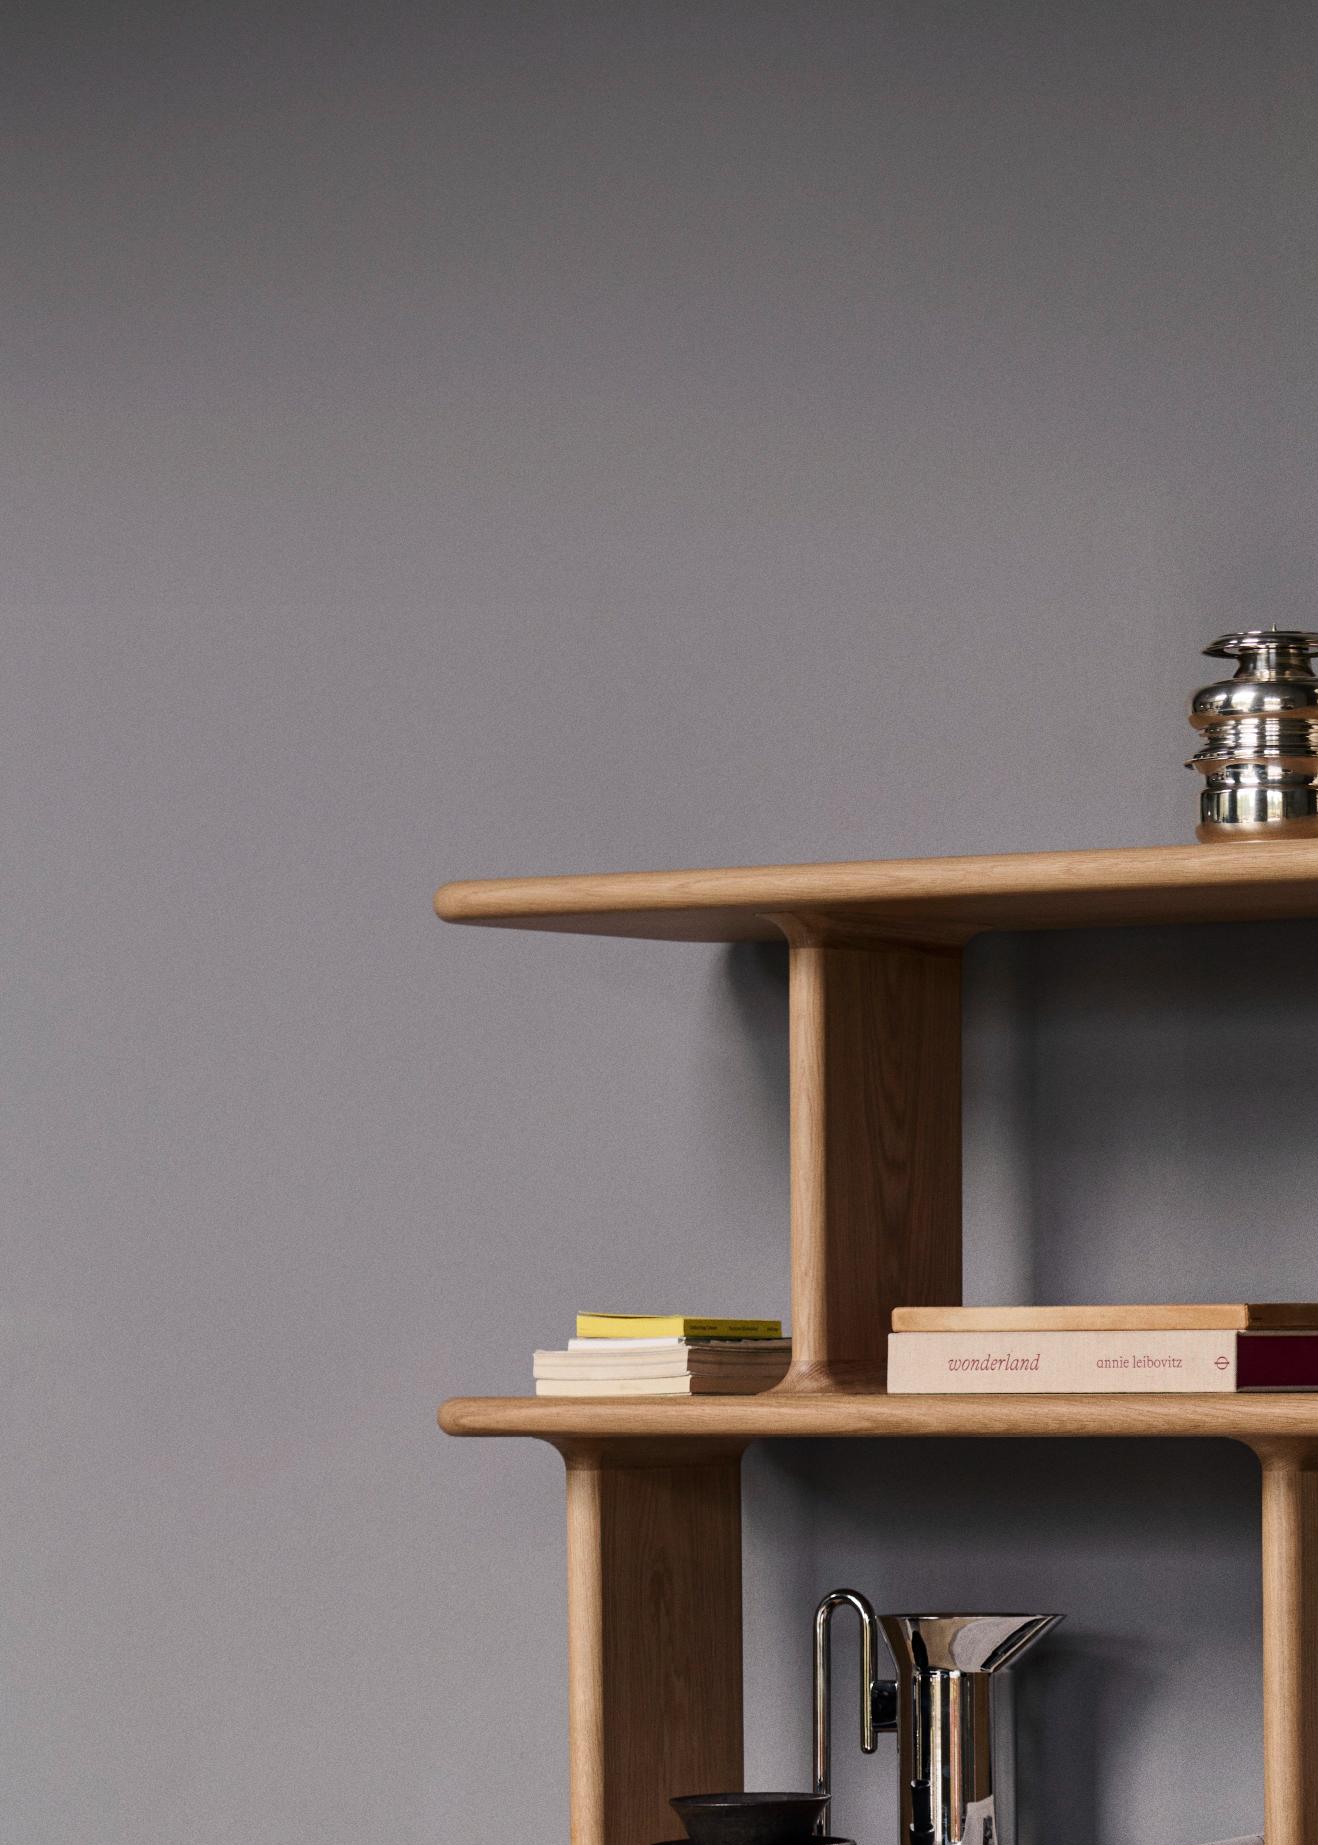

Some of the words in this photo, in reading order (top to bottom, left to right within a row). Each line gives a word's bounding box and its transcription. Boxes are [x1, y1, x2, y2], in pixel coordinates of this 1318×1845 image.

[948, 1353, 1040, 1372] wonderland
[1096, 1355, 1129, 1369] annie
[1132, 1354, 1183, 1369] leibovitz
